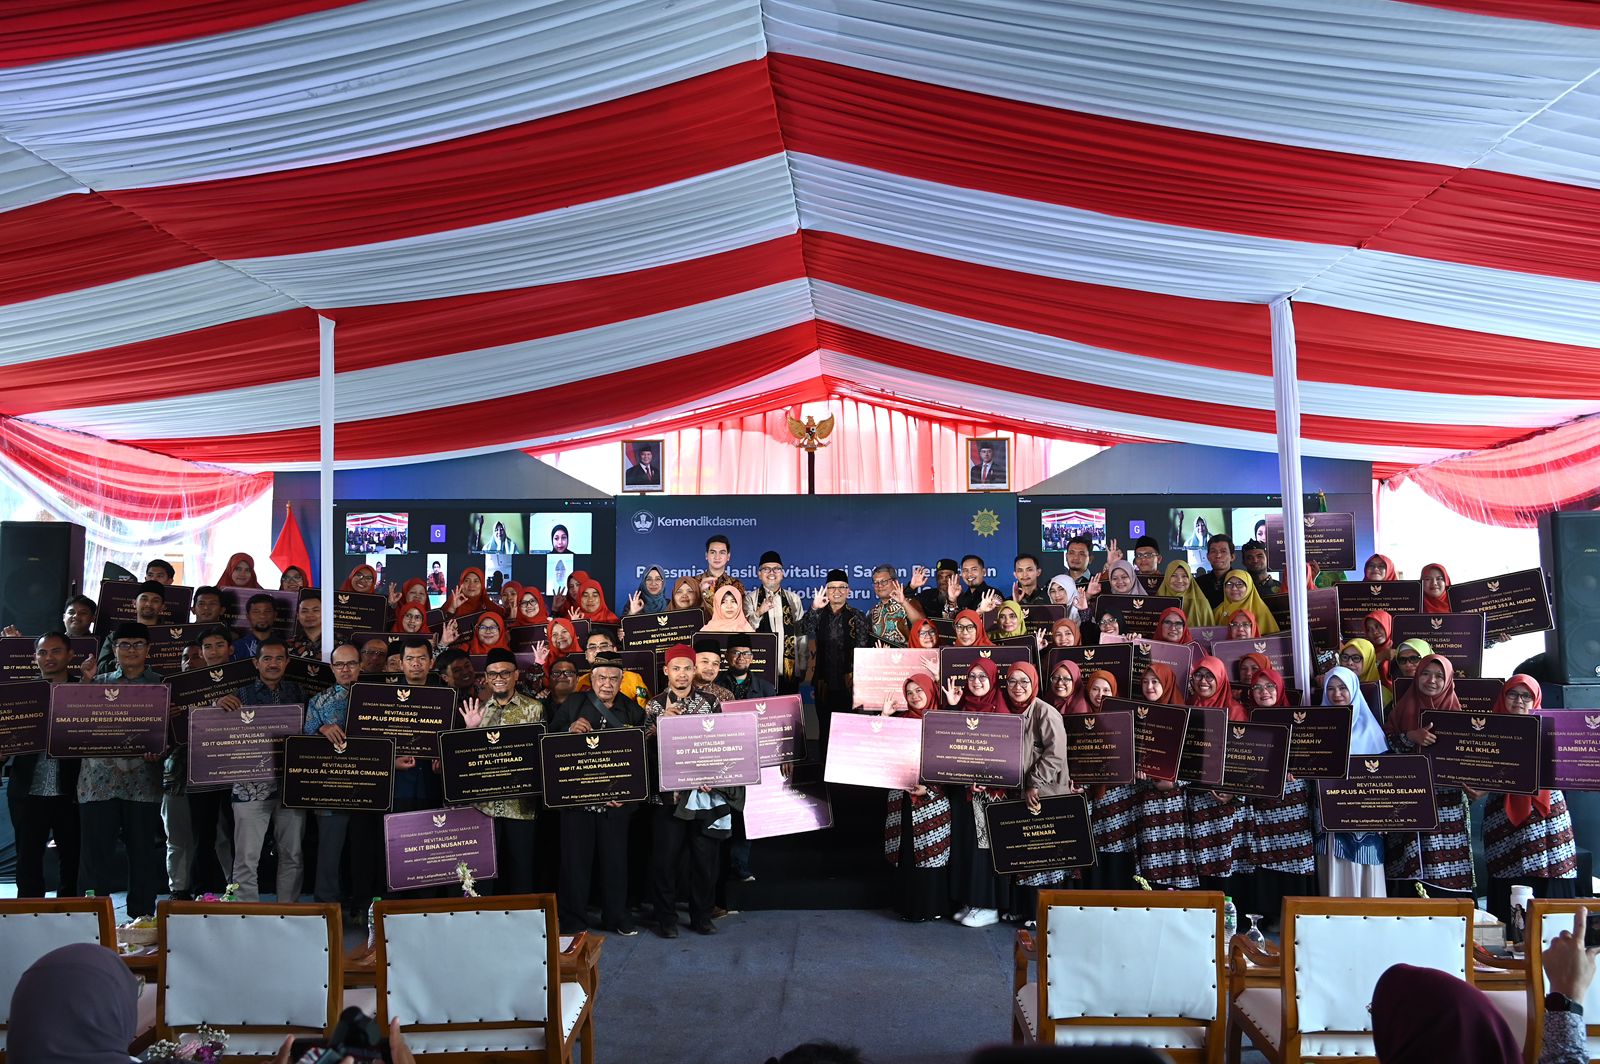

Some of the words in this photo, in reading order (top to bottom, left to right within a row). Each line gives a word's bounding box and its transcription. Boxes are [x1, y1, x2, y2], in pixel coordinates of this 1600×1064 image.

[657, 516, 757, 527] Kemendikdasmen
[434, 529, 441, 538] G
[1134, 525, 1140, 534] G
[847, 588, 871, 599] aru
[0, 712, 44, 721] ANCABANGO
[478, 751, 512, 759] REVITALISASI
[1022, 823, 1054, 831] REVITALISASI
[424, 835, 457, 843] REVITALISASI
[441, 839, 478, 848] NUSANTARA
